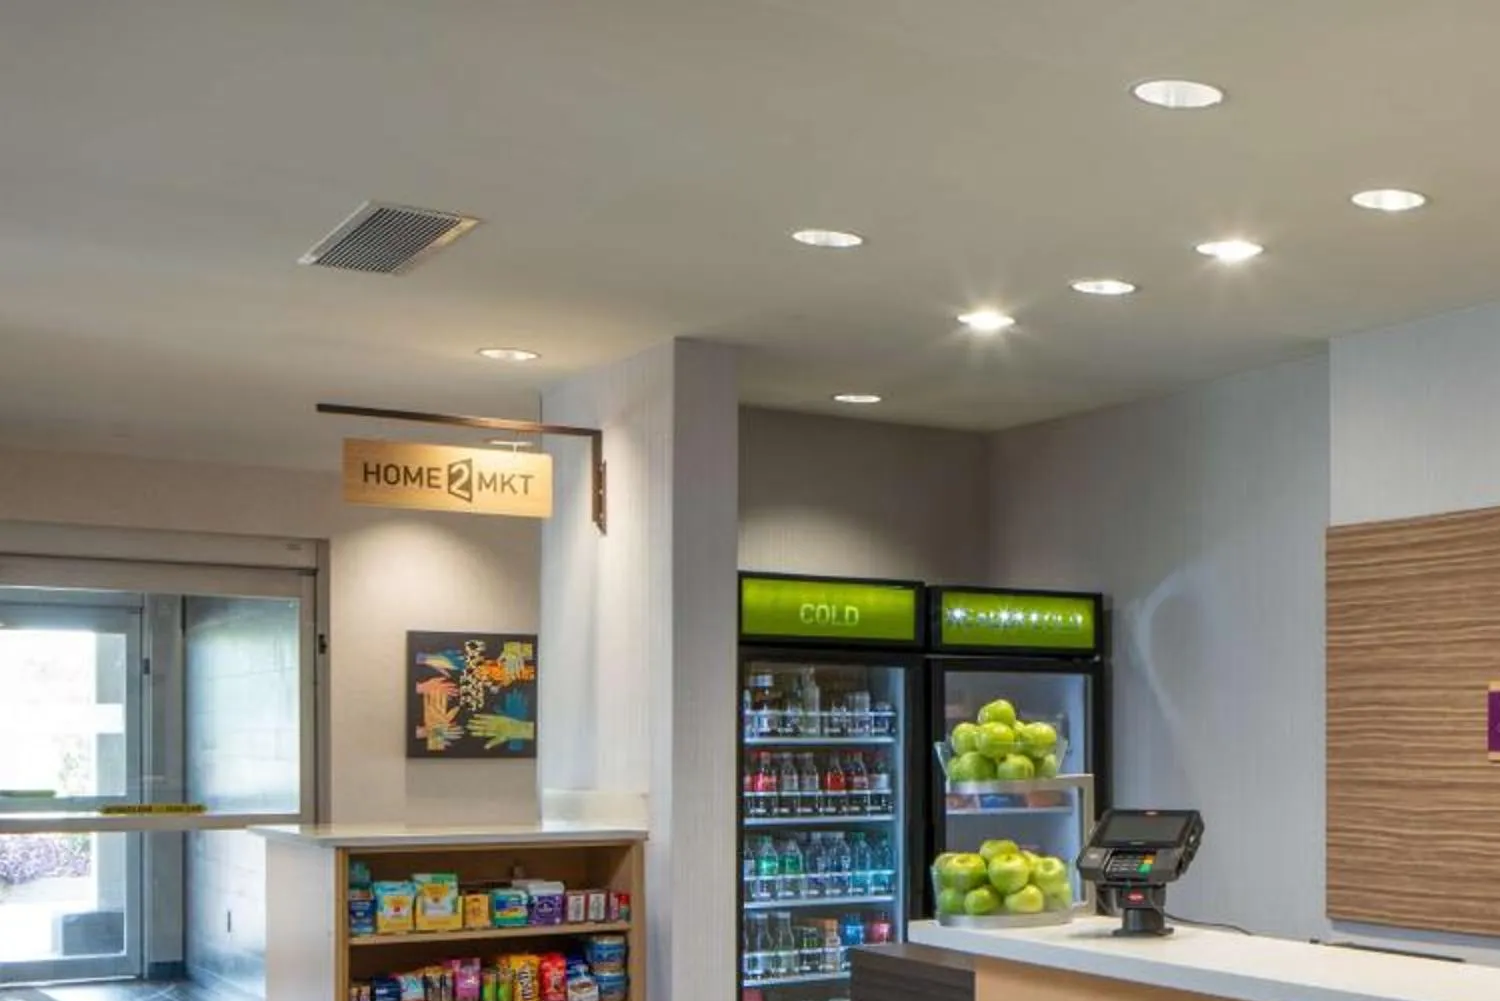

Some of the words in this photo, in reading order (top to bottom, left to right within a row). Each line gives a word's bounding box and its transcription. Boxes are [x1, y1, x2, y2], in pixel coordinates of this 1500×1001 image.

[362, 462, 442, 489] HOME
[449, 462, 471, 500] 2
[477, 471, 534, 496] MKT
[800, 603, 859, 627] COLD
